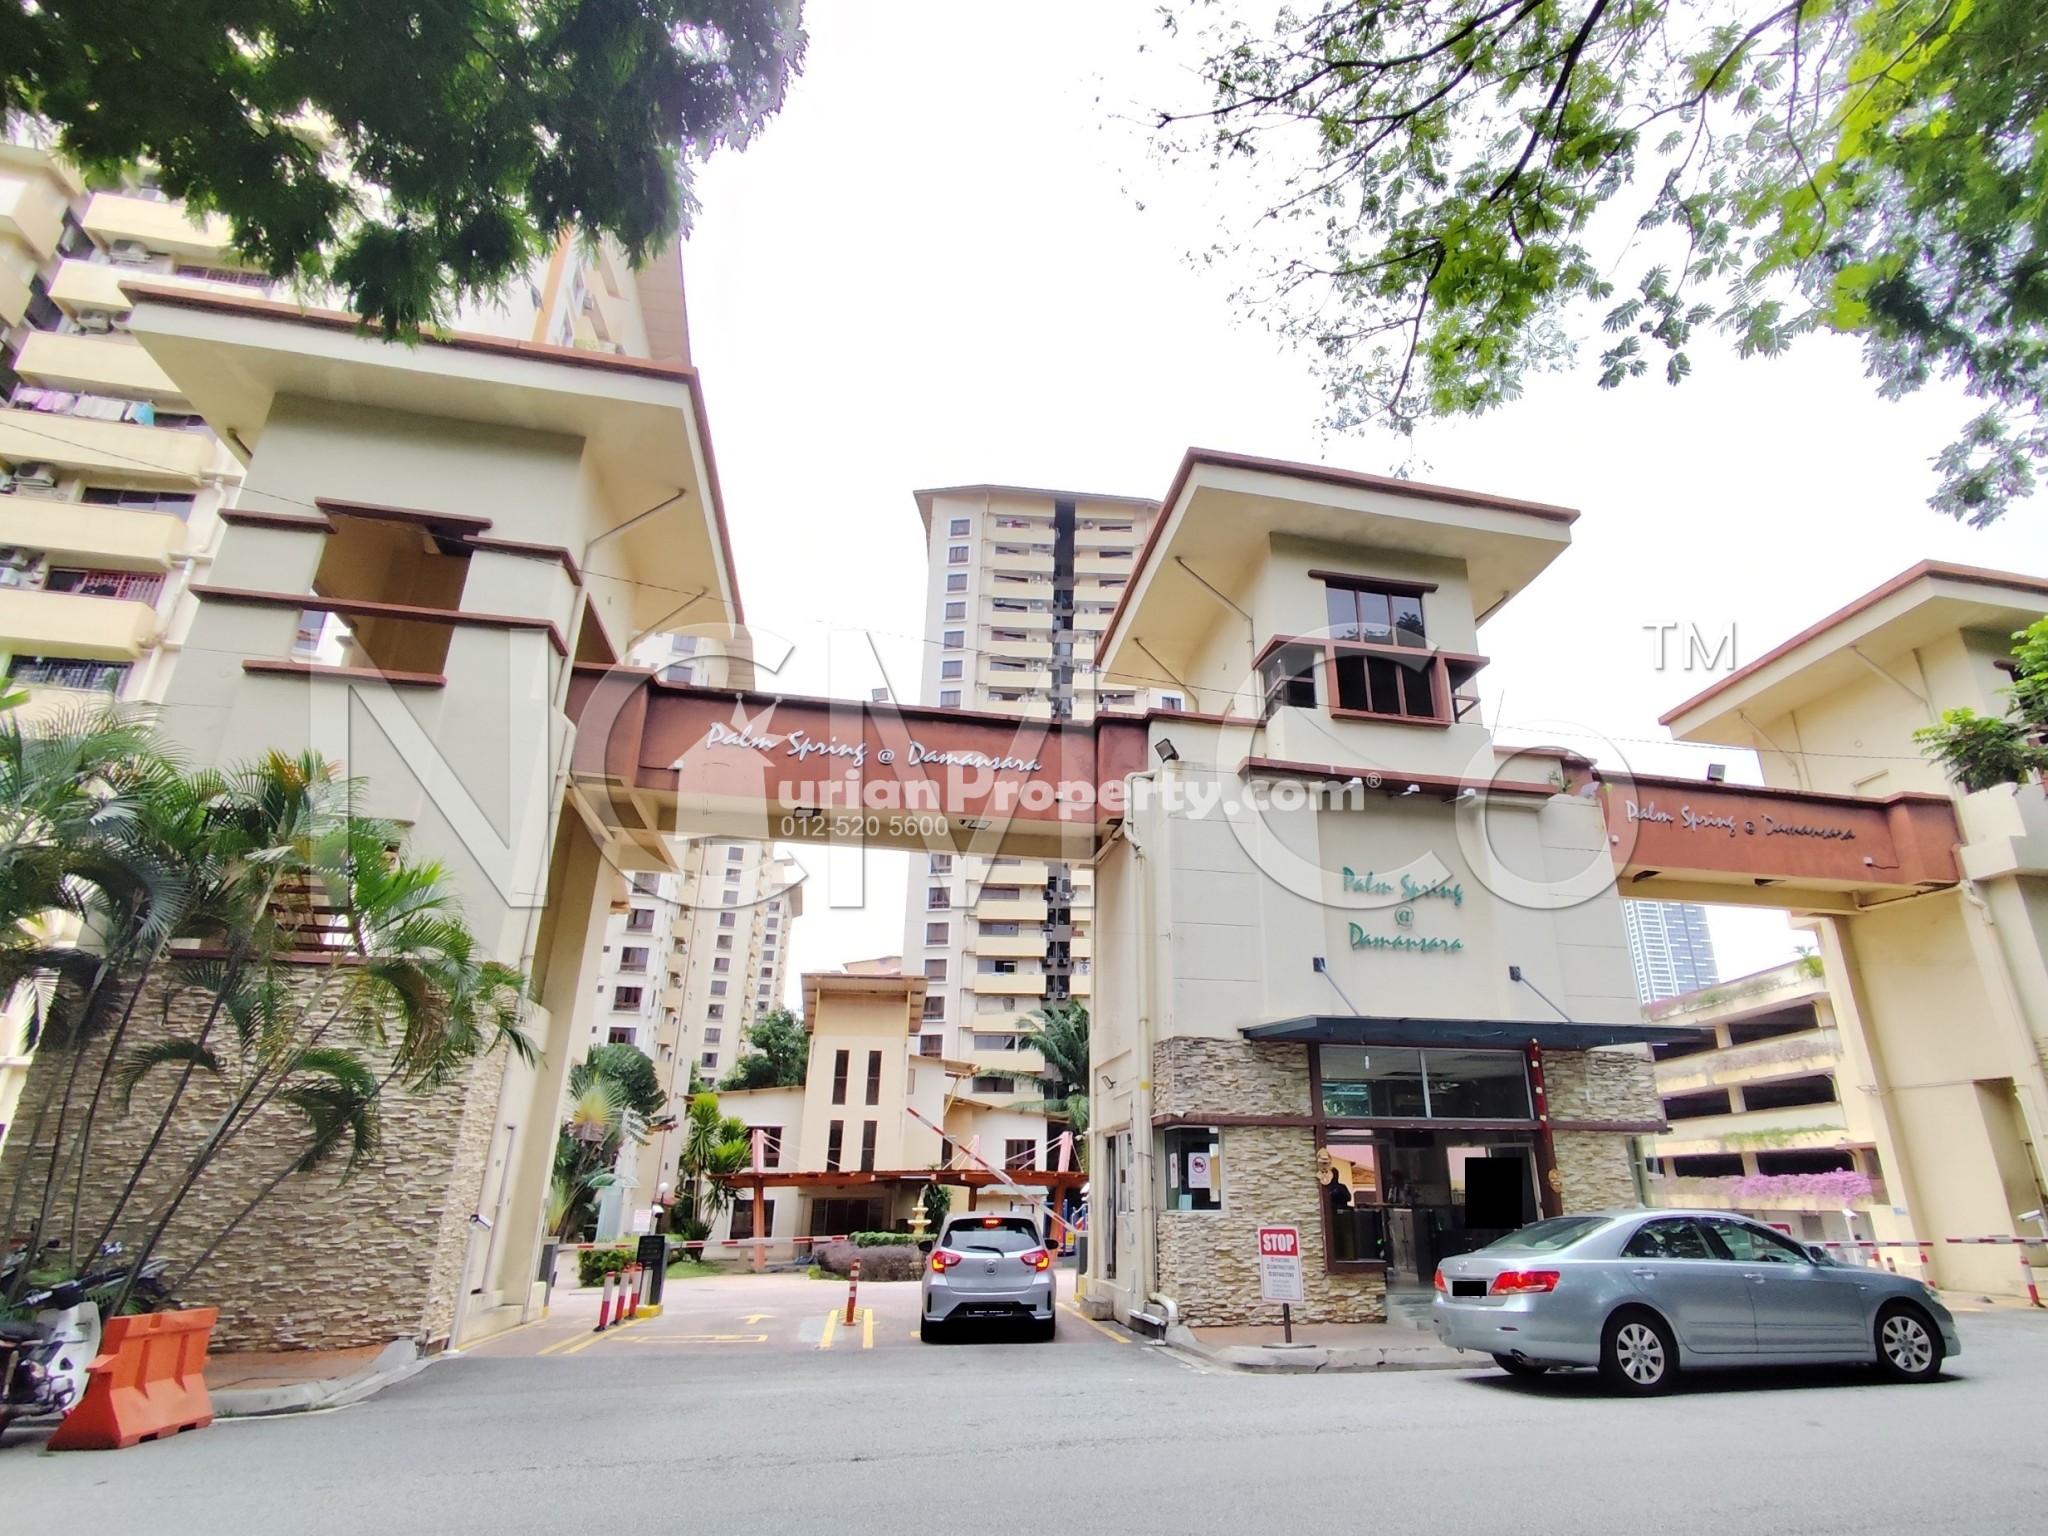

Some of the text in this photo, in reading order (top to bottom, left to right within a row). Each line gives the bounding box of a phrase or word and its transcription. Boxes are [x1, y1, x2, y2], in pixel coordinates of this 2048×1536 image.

[705, 721, 1044, 773] Palm Spring @ Damansara
[1625, 800, 1675, 823] Palm
[1680, 805, 1737, 837] Spring
[1342, 866, 1464, 907] Palm Spring
[1395, 905, 1415, 927] @
[1348, 921, 1465, 951] Damansara
[1262, 1233, 1295, 1252] STOP
